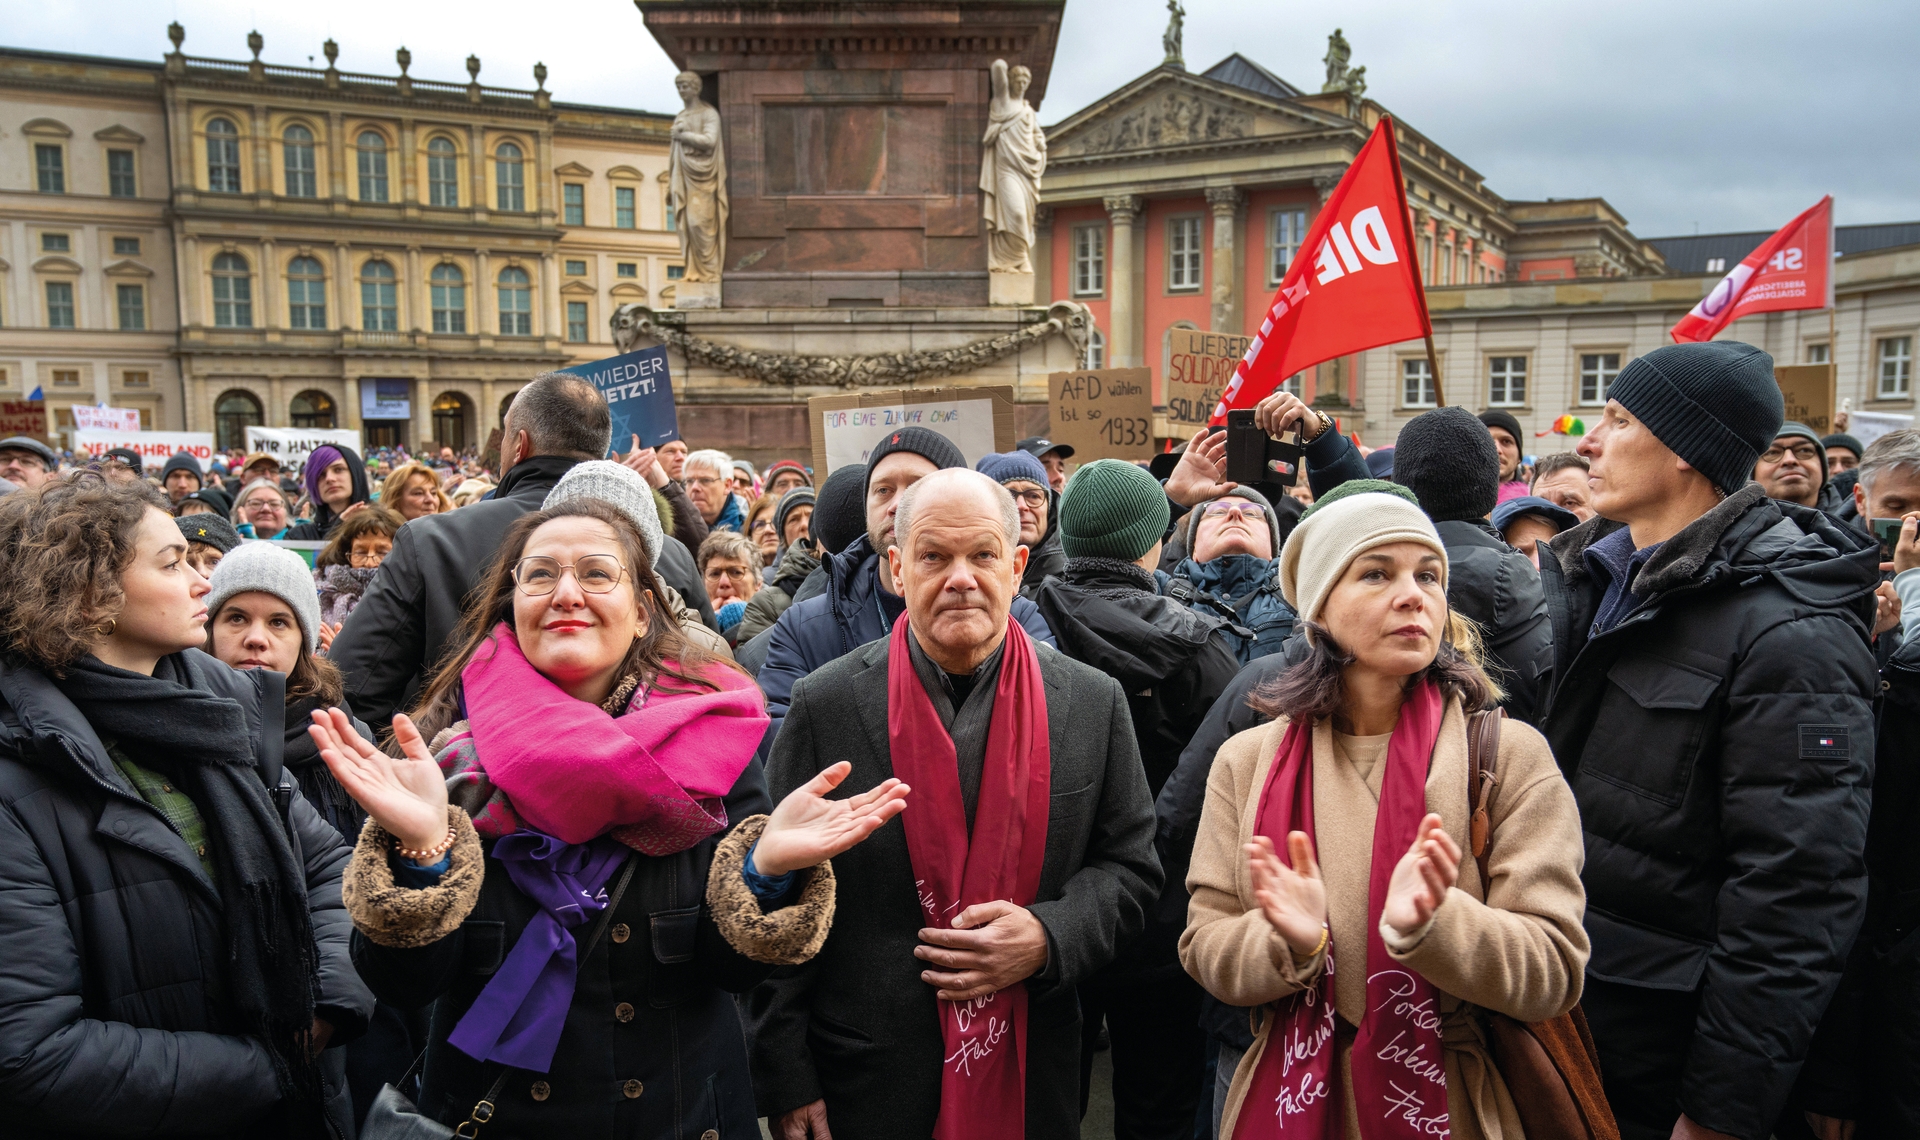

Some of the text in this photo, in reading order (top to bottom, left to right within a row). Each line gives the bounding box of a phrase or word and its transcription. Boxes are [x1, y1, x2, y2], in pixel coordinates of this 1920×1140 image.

[1189, 335, 1248, 359] LIEBER
[586, 357, 664, 387] WIEDER
[1170, 353, 1241, 386] SOLIDARI
[1060, 375, 1142, 400] AfD wählen
[1200, 387, 1223, 402] ALS
[853, 412, 876, 427] EINE
[930, 410, 958, 423] OHNE
[1060, 406, 1102, 422] ist so
[1100, 417, 1148, 446] 1933
[254, 439, 280, 452] WIR
[945, 1016, 1010, 1077] Farbe
[1275, 1072, 1330, 1129] Farbe
